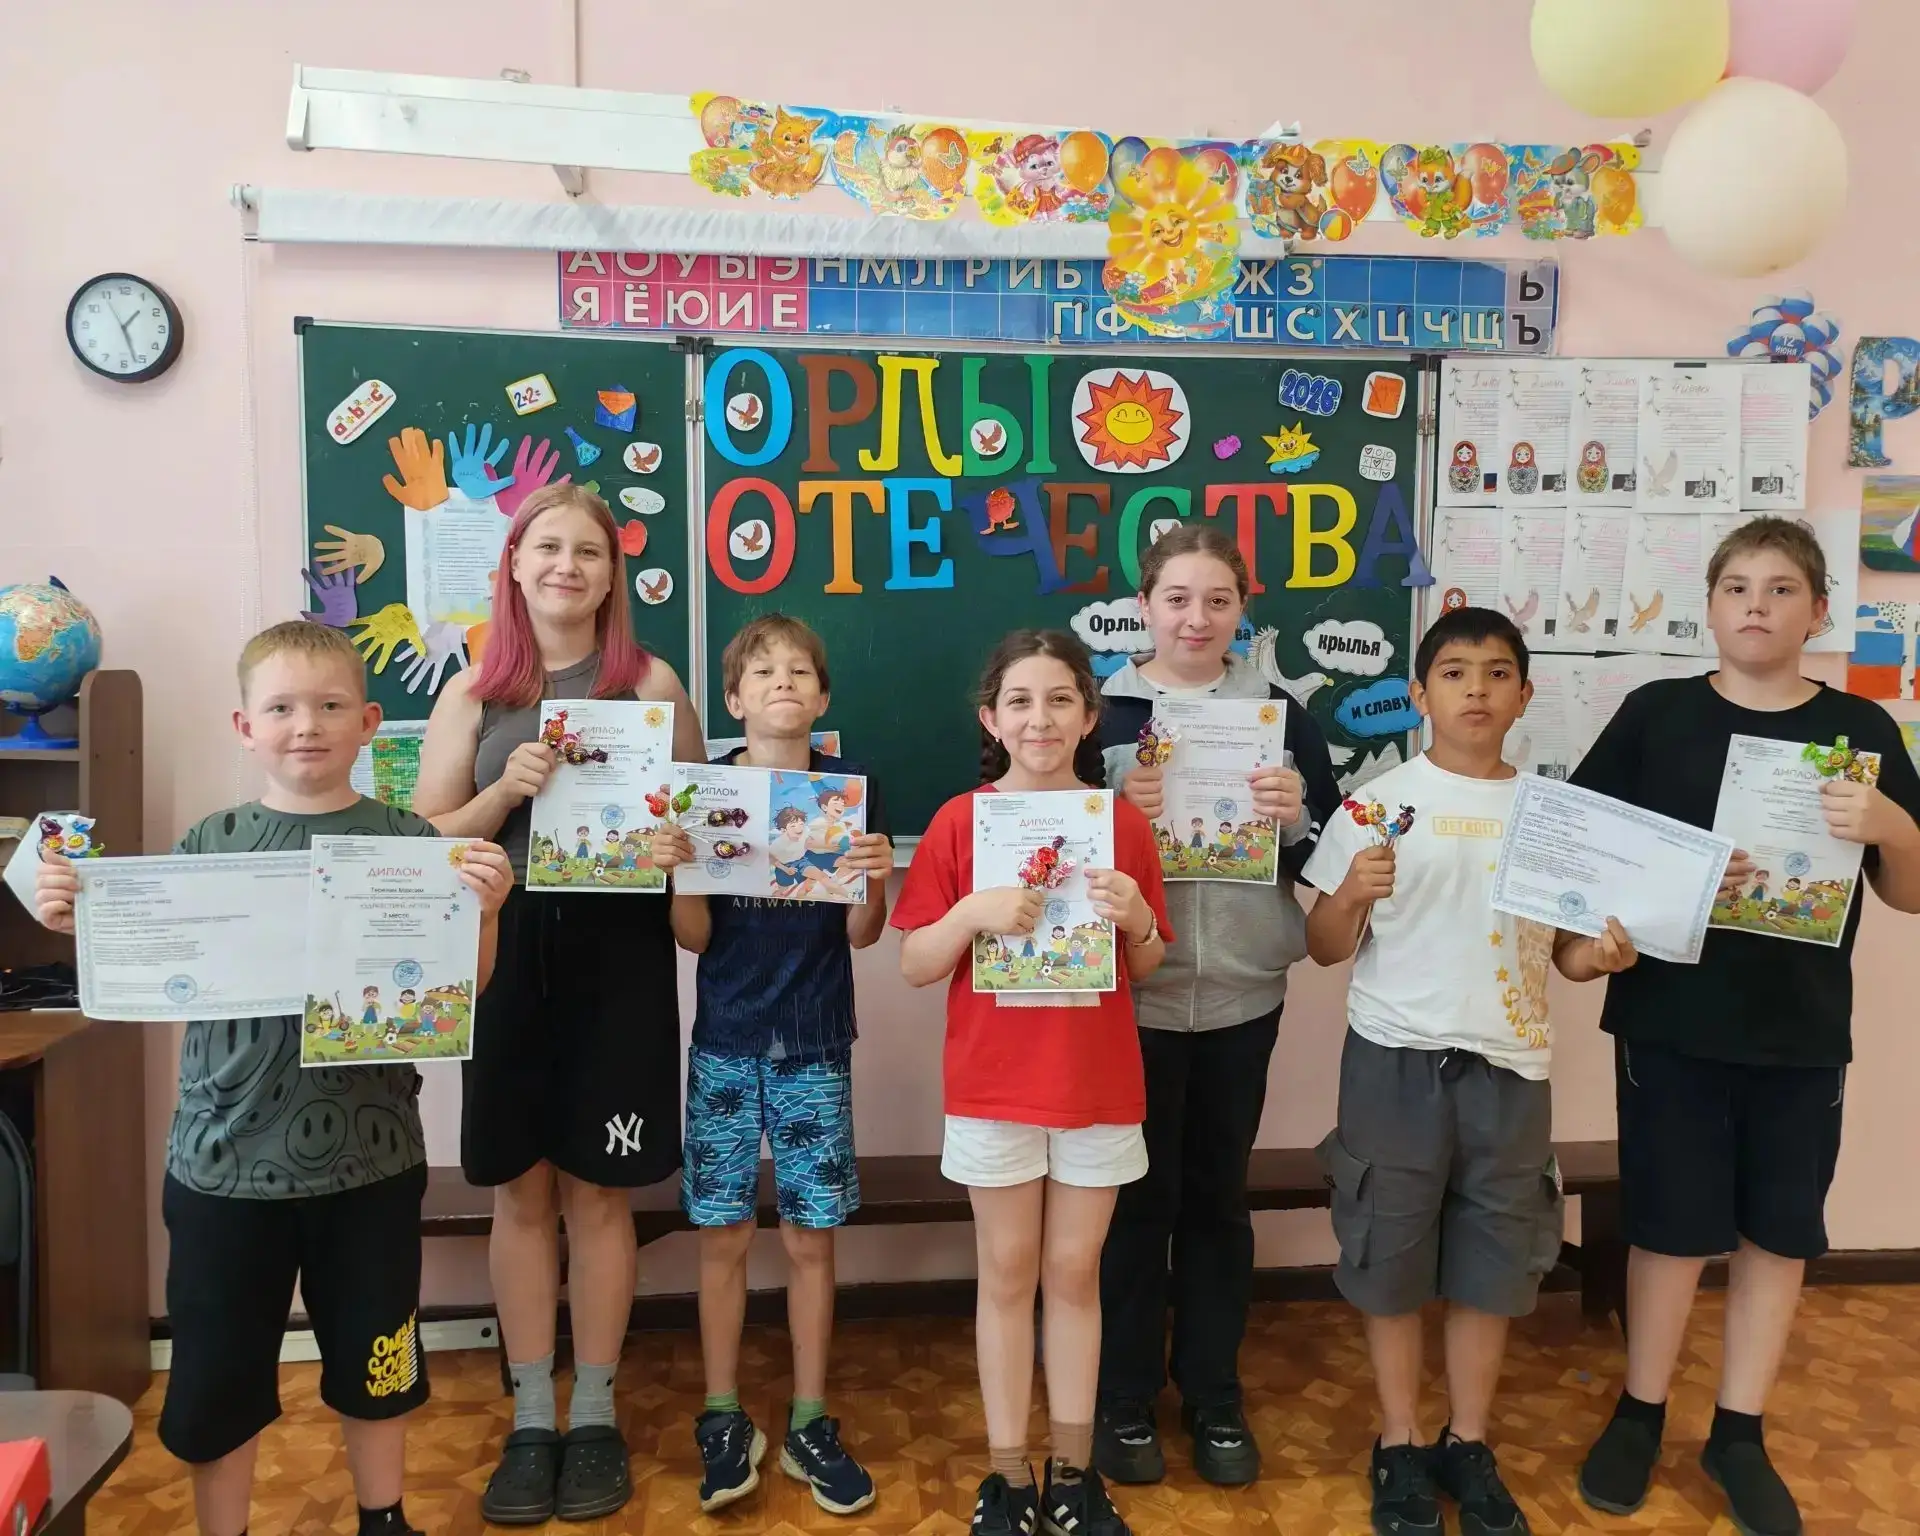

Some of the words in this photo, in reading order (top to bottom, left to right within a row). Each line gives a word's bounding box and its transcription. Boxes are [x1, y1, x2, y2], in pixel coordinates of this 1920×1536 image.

[1782, 334, 1796, 347] 12
[1282, 371, 1340, 415] 2026
[704, 348, 1057, 477] ОРЛЫ
[706, 476, 1437, 595] ОТЕЧЕСТВА
[1317, 632, 1382, 657] крылья
[694, 786, 739, 797] ДИПЛОМ
[1019, 817, 1065, 828] ДИПЛОМ
[367, 867, 422, 878] ДИПЛОМ
[605, 1111, 644, 1156] NY
